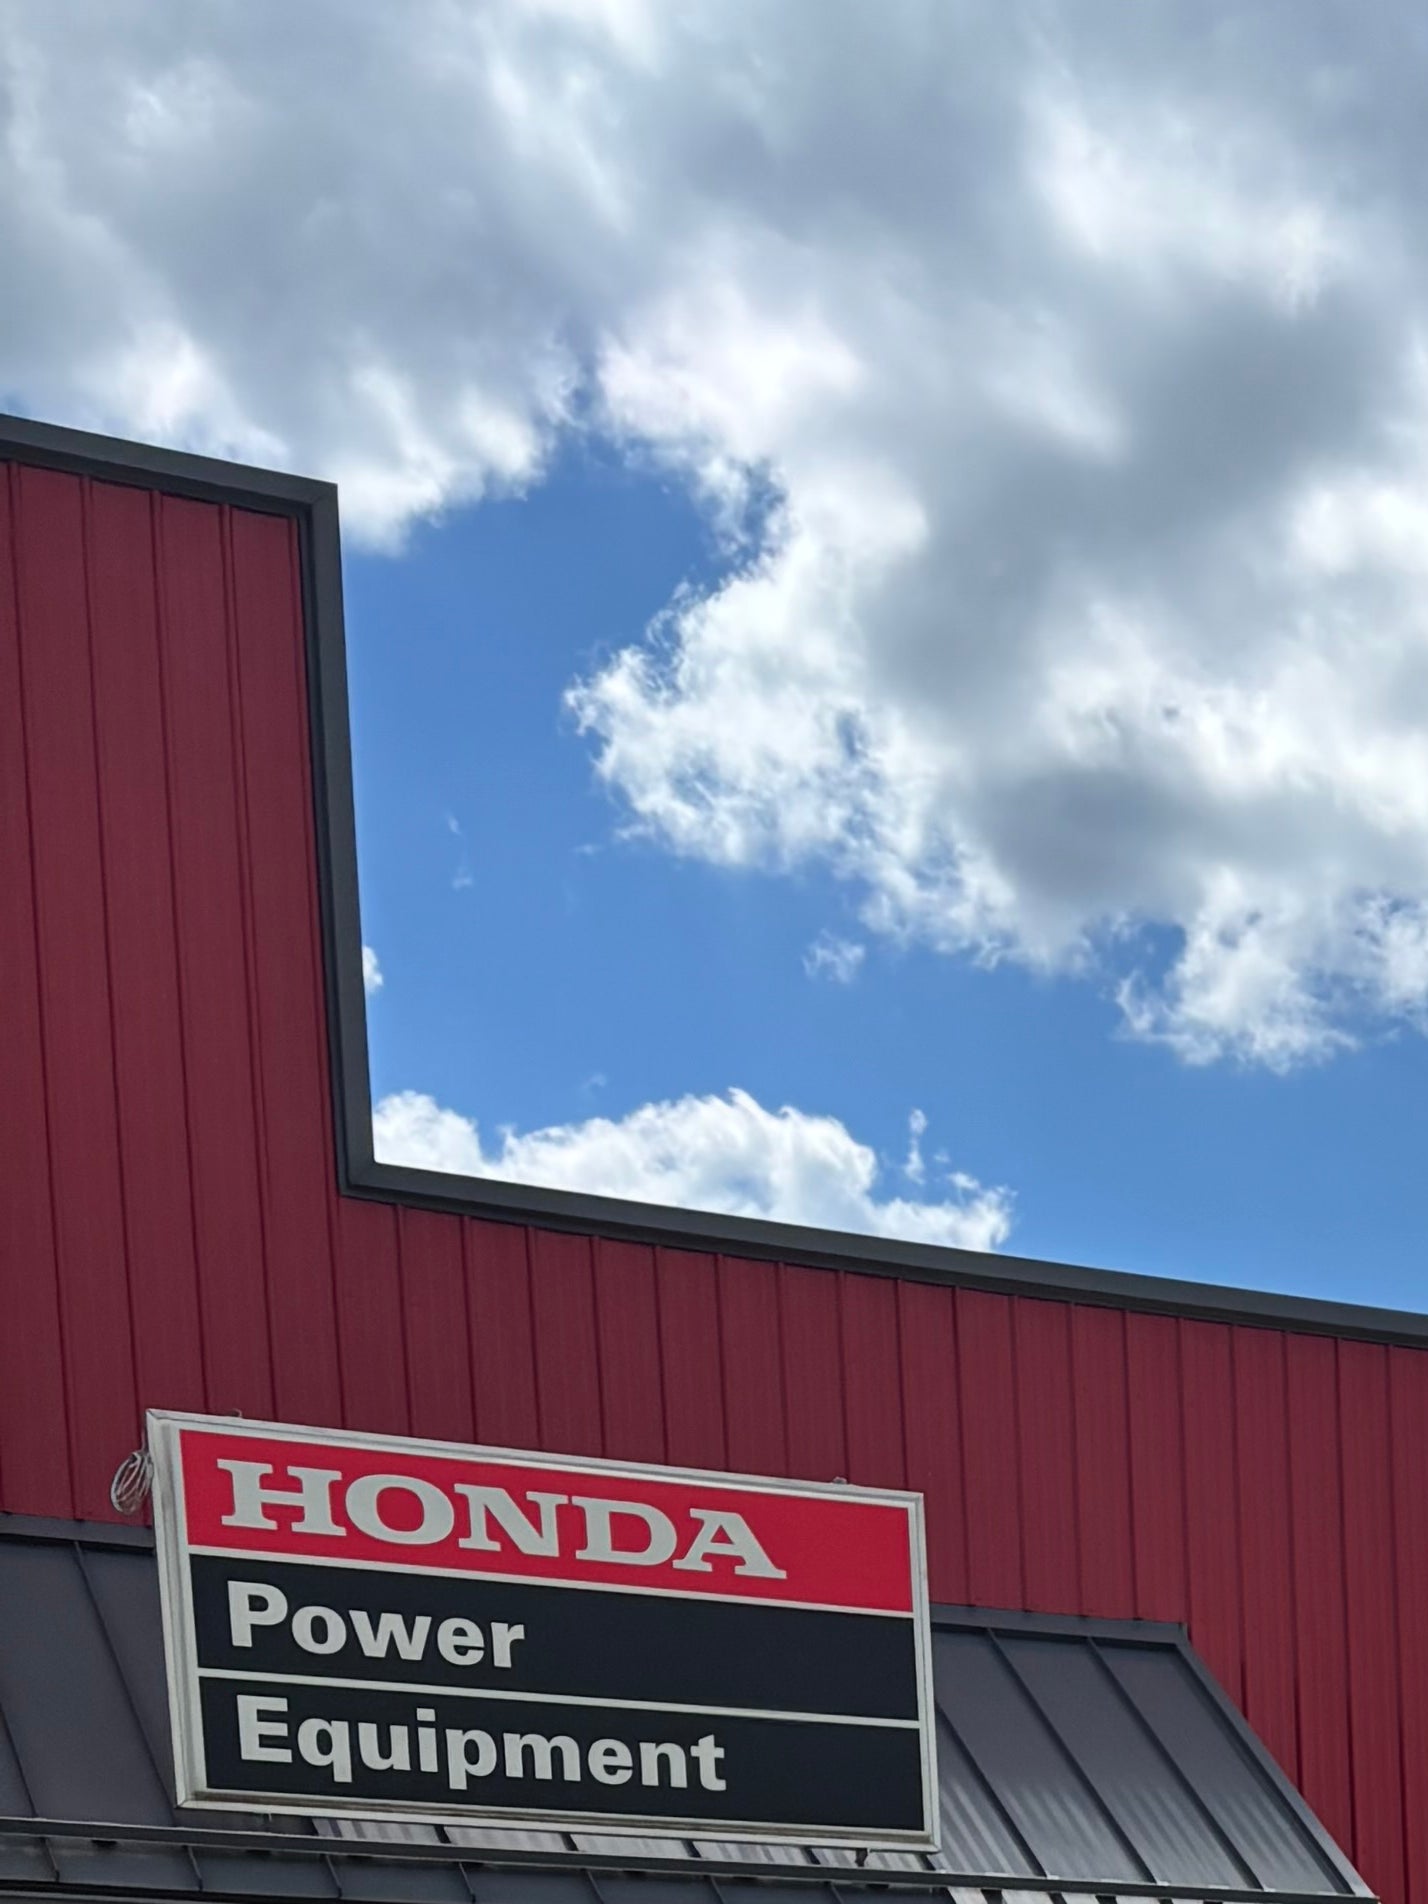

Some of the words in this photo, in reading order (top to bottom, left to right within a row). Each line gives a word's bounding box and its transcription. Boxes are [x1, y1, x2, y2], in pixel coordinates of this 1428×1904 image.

[217, 1458, 787, 1580] HONDA
[226, 1580, 526, 1669] Power
[236, 1695, 727, 1792] Equipment
